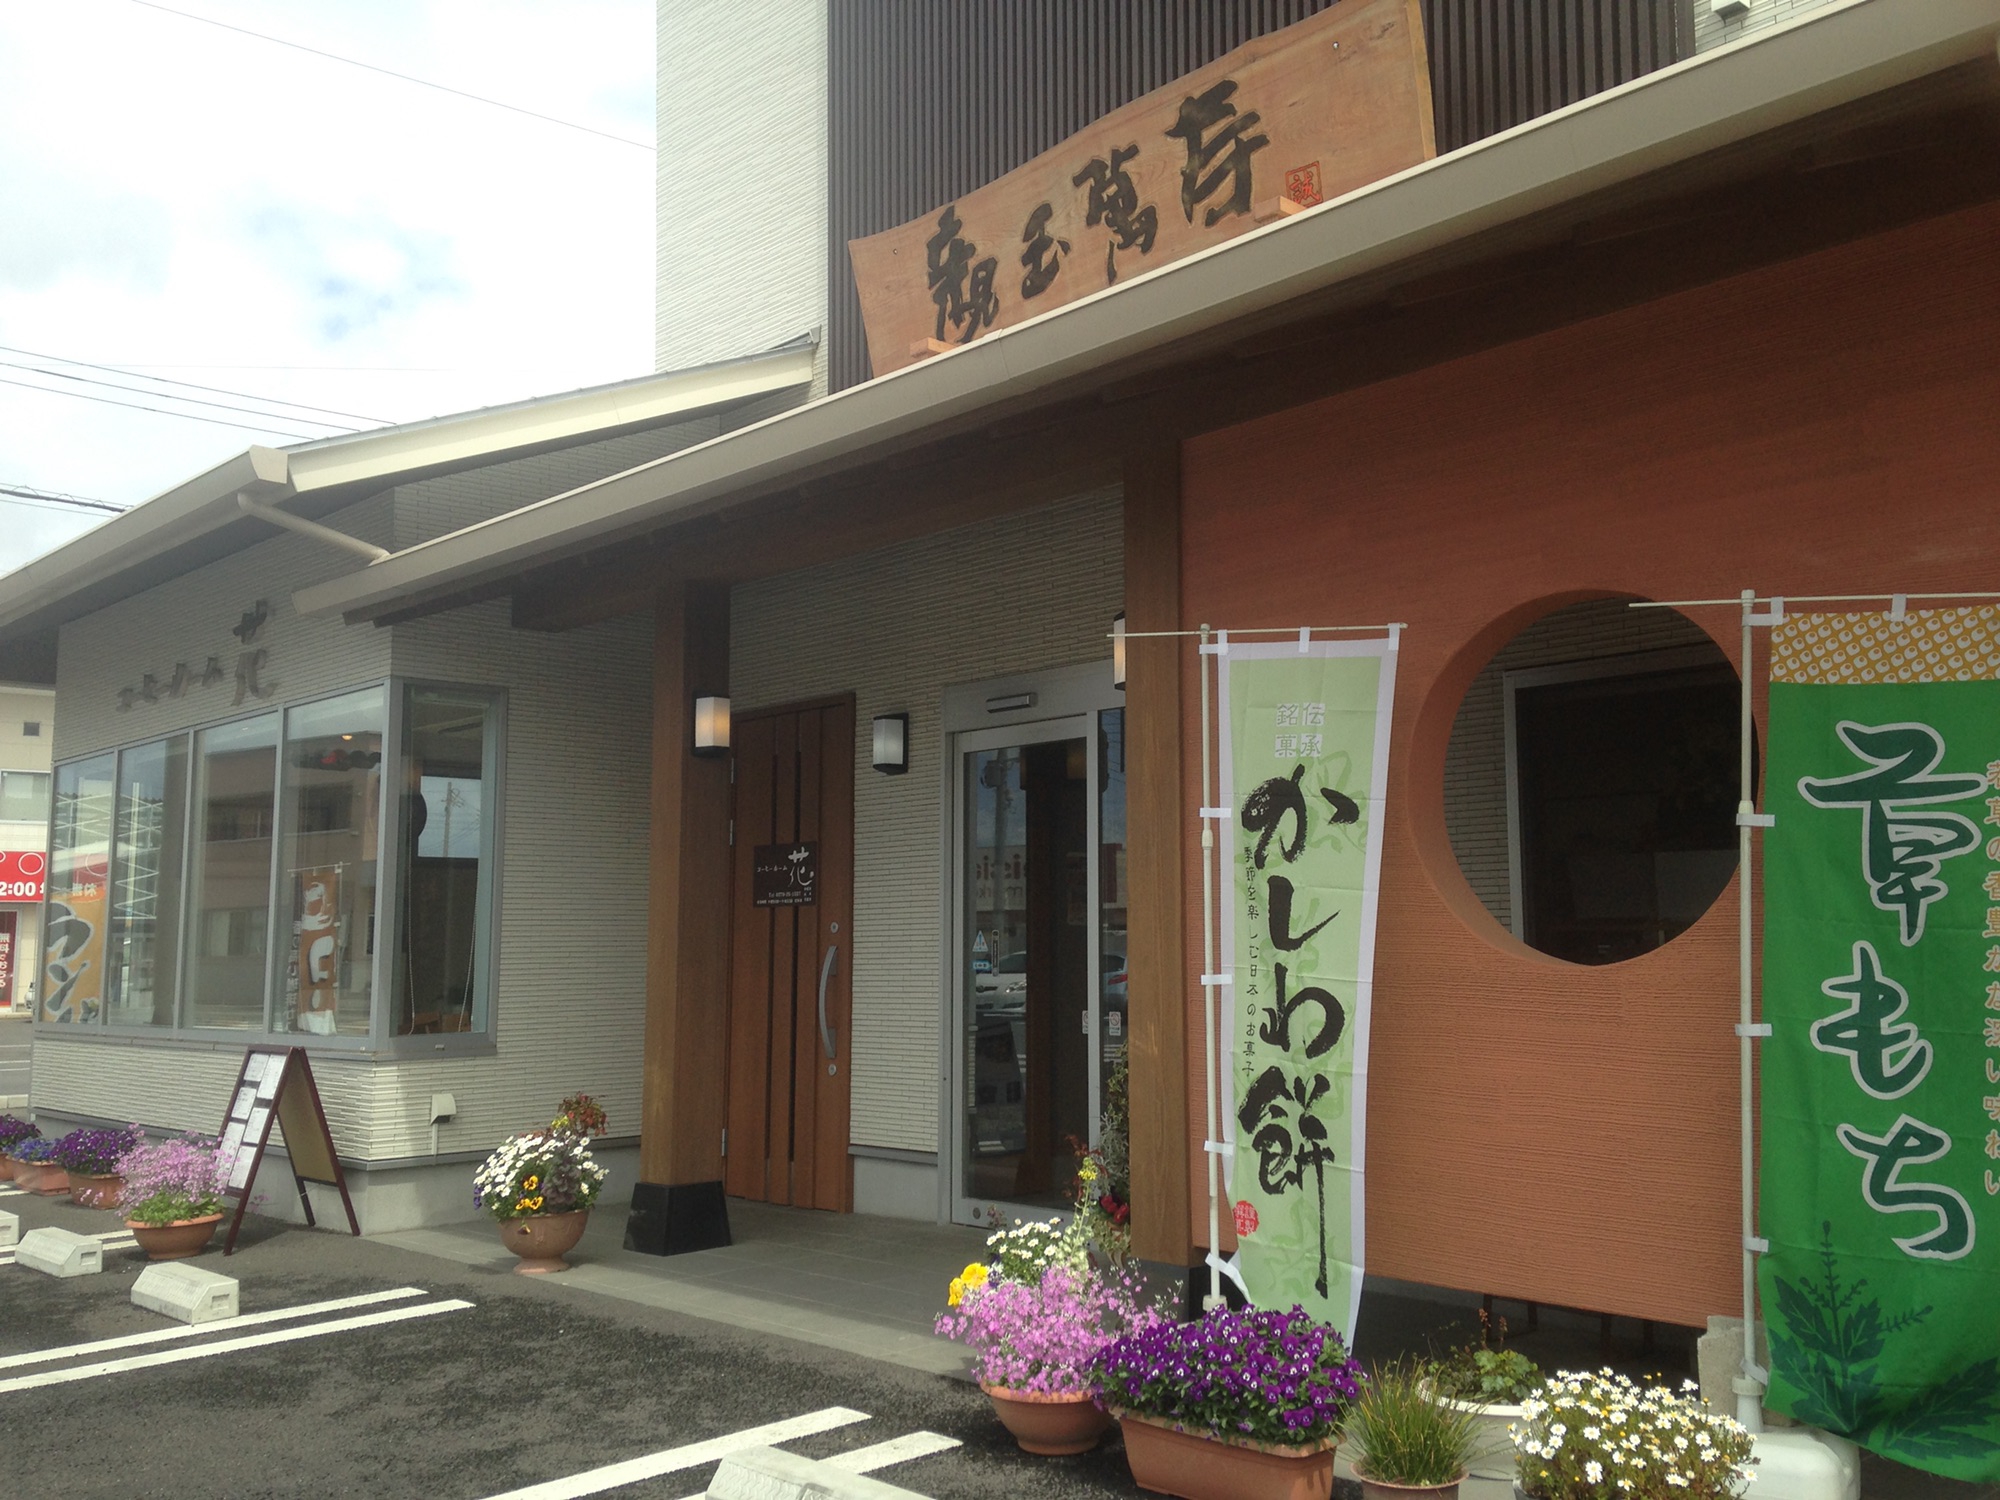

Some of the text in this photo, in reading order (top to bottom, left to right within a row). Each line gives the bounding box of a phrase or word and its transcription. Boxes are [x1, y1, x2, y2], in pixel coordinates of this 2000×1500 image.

[1237, 763, 1361, 1300] かしわ餅
[1242, 846, 1259, 1078] 季節を楽しむ日本のお菓子
